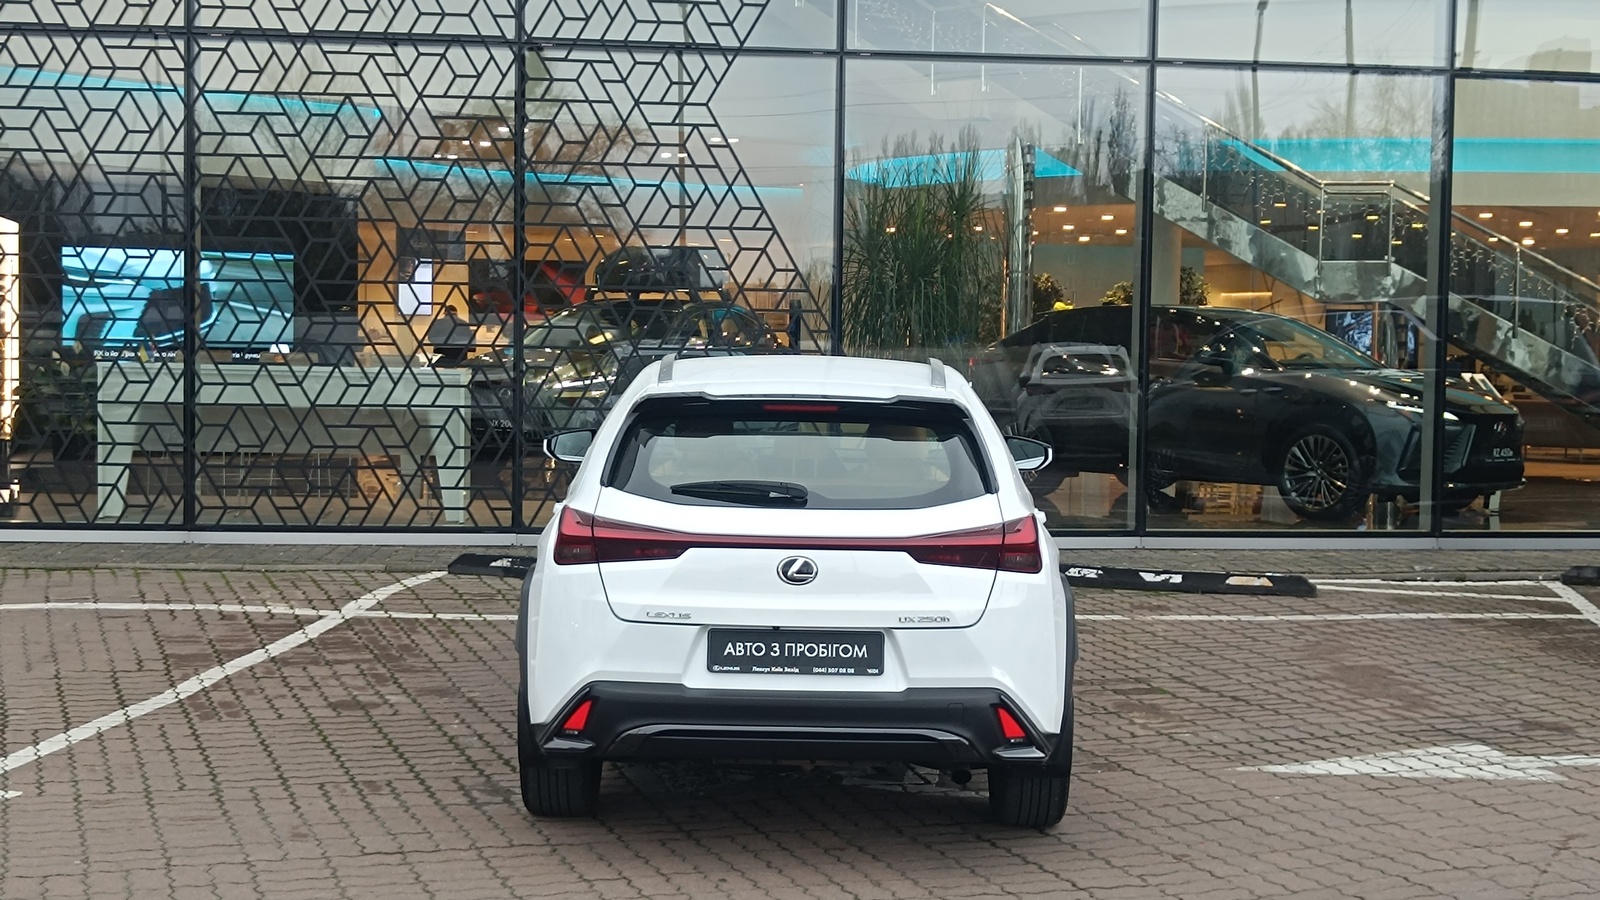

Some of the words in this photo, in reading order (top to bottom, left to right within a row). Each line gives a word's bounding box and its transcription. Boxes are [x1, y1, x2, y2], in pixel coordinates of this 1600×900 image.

[646, 611, 692, 619] LEXUS
[724, 642, 766, 656] АВТО
[785, 643, 868, 658] ПРОБІГОМ
